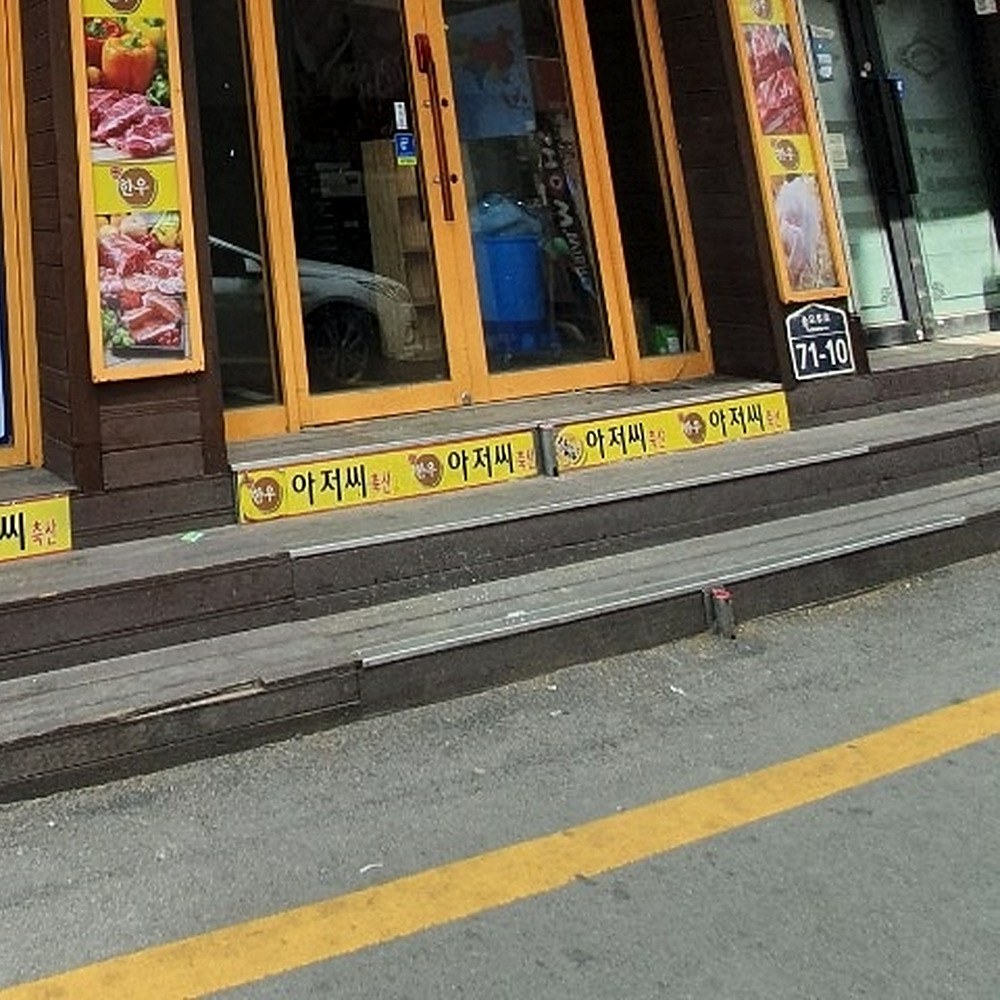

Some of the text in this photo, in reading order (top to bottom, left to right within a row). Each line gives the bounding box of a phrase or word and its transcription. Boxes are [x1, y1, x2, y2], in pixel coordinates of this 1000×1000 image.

[120, 177, 150, 197] 한우
[795, 338, 848, 370] 71-10
[585, 422, 647, 459] 아저씨
[709, 403, 766, 438] 아저씨
[292, 464, 368, 505] 아저씨
[447, 442, 515, 482] 아저씨
[31, 519, 57, 546] 축산
